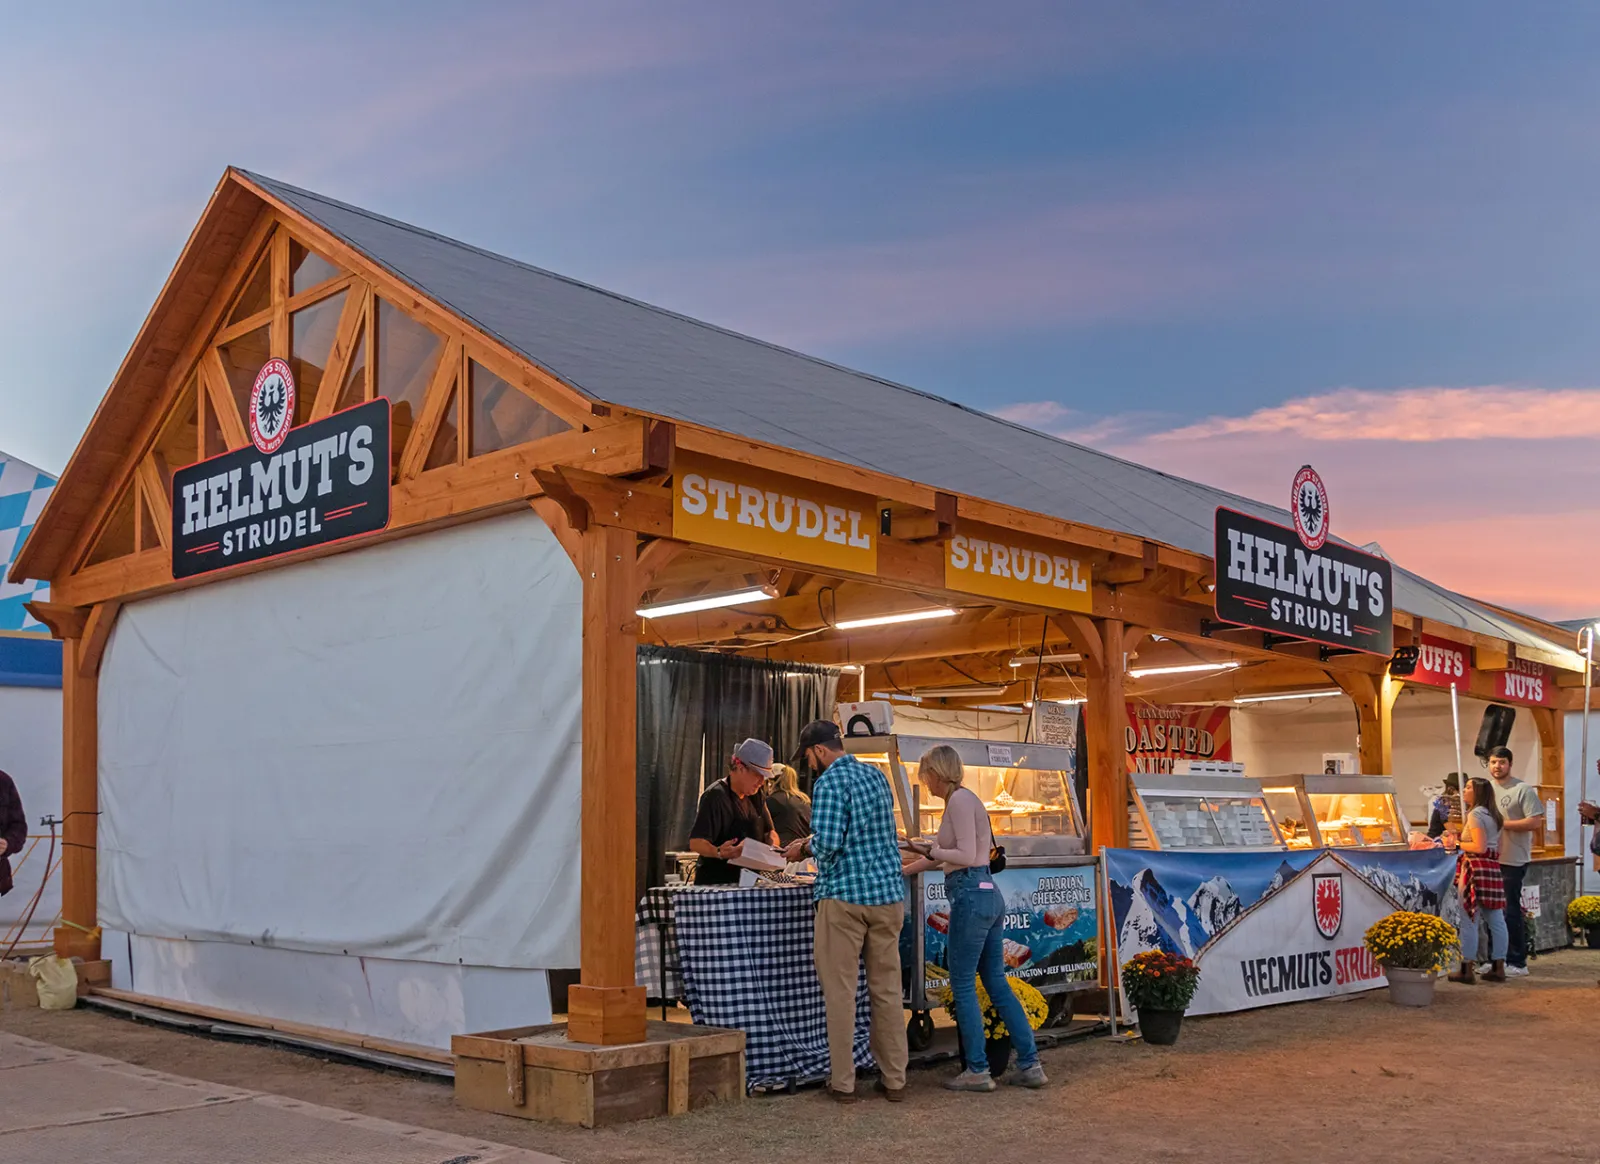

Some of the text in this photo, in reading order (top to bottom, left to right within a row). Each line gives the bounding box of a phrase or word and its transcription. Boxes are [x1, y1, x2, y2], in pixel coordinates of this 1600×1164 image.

[274, 362, 294, 401] STRUDEL
[182, 425, 375, 536] HELMUT'S
[681, 473, 870, 550] STRUDEL
[222, 507, 321, 556] STRUDEL
[950, 535, 1087, 592] STRUDEL
[1227, 528, 1384, 617] HELMUT'S
[1270, 597, 1352, 637] STRUDEL
[1418, 644, 1463, 678] UFFS
[1515, 659, 1543, 677] ASTED
[1504, 671, 1543, 702] NUTS
[1124, 724, 1214, 757] OASTED
[1135, 757, 1175, 775] NUT
[927, 883, 947, 900] CHE
[1031, 888, 1091, 906] CHEESECAKE
[1038, 875, 1084, 891] BAVARIAN
[1002, 913, 1031, 930] PPLE
[1047, 965, 1060, 975] BEEF
[1060, 961, 1098, 973] WELLINGTON
[1240, 950, 1332, 997] HELMUT'S
